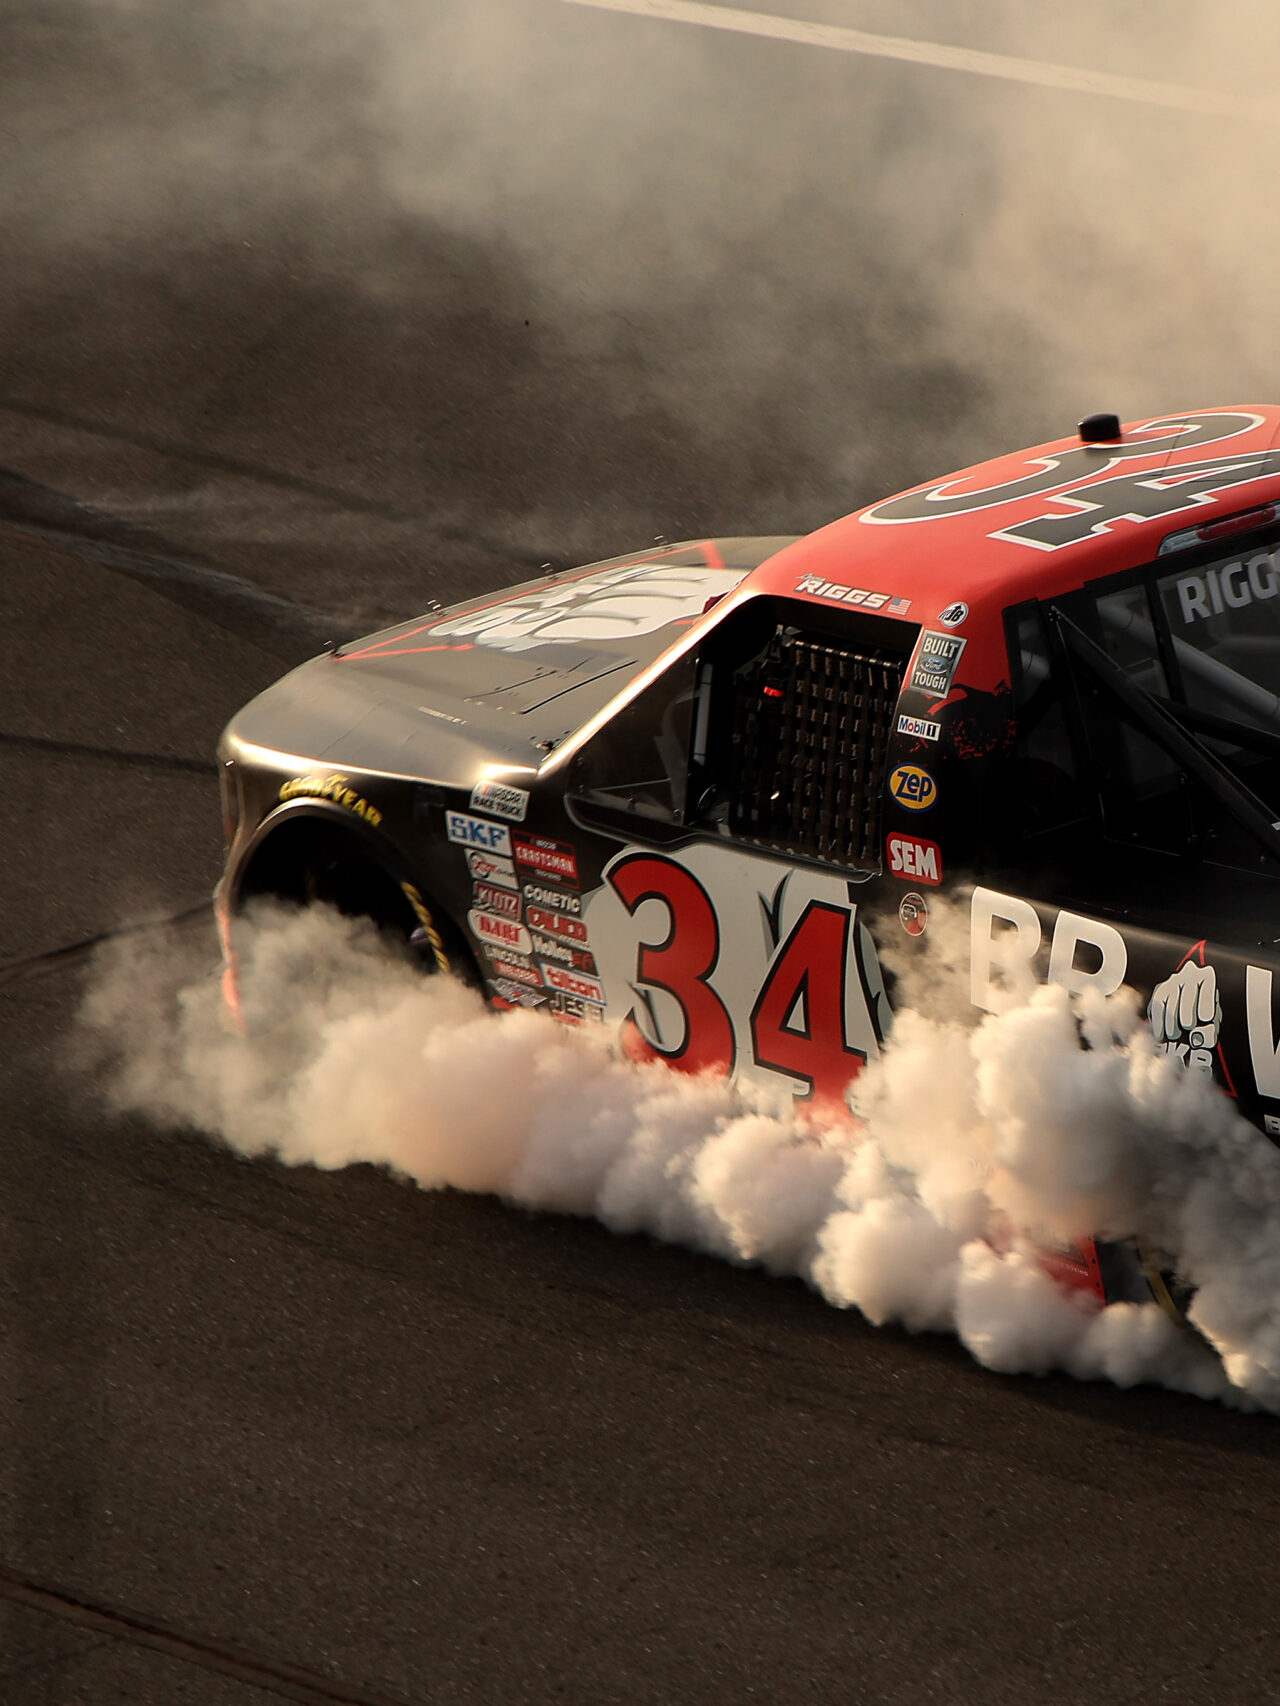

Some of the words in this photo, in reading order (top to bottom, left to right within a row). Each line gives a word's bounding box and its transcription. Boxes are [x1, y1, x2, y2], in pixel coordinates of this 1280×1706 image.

[794, 579, 891, 610] RIGGS
[923, 637, 958, 657] BUILT
[914, 671, 946, 690] TOUGH
[900, 717, 926, 736] Mobil
[451, 816, 506, 847] SKF
[515, 846, 574, 873] CRAFTSMAN
[890, 839, 938, 880] SEM
[478, 886, 519, 914] KLOTZ
[524, 884, 581, 913] COMETIC
[603, 850, 869, 1120] 34
